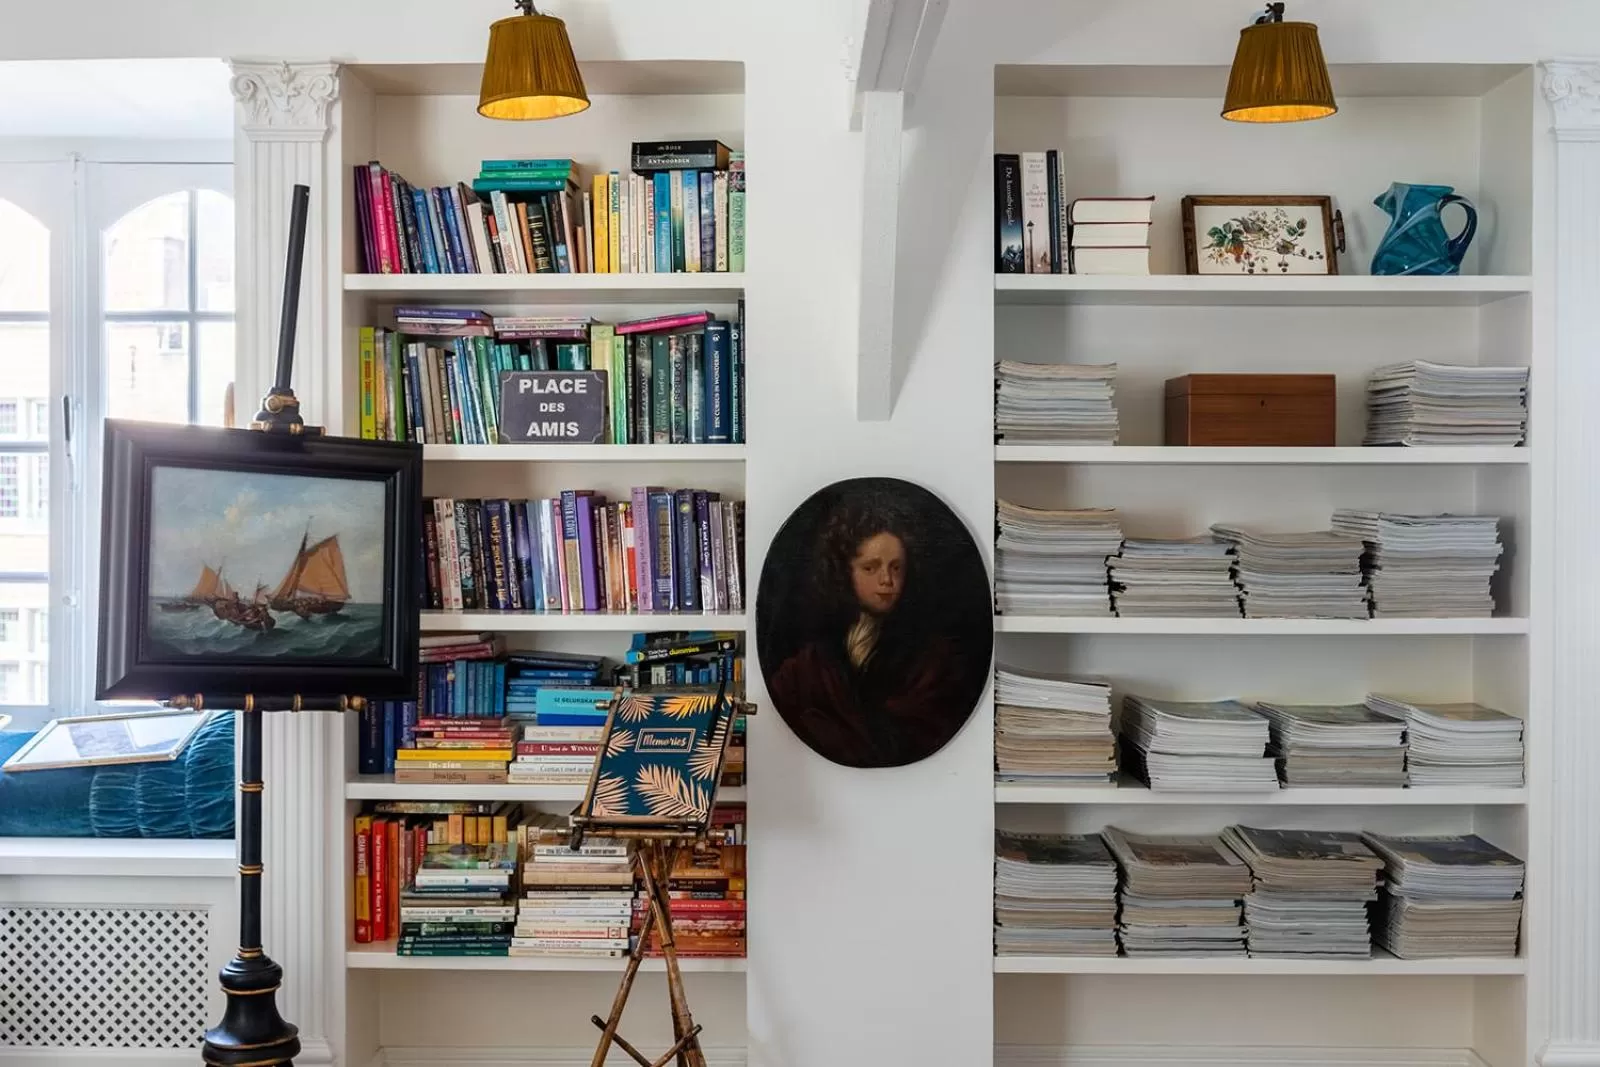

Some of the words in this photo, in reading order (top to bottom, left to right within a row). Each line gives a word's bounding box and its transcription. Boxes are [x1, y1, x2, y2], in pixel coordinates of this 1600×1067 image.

[518, 379, 587, 394] PLACE
[540, 403, 565, 412] DES
[526, 422, 580, 436] AMIS
[669, 646, 700, 656] dummies
[642, 734, 687, 747] Memories
[428, 761, 462, 769] In-zien
